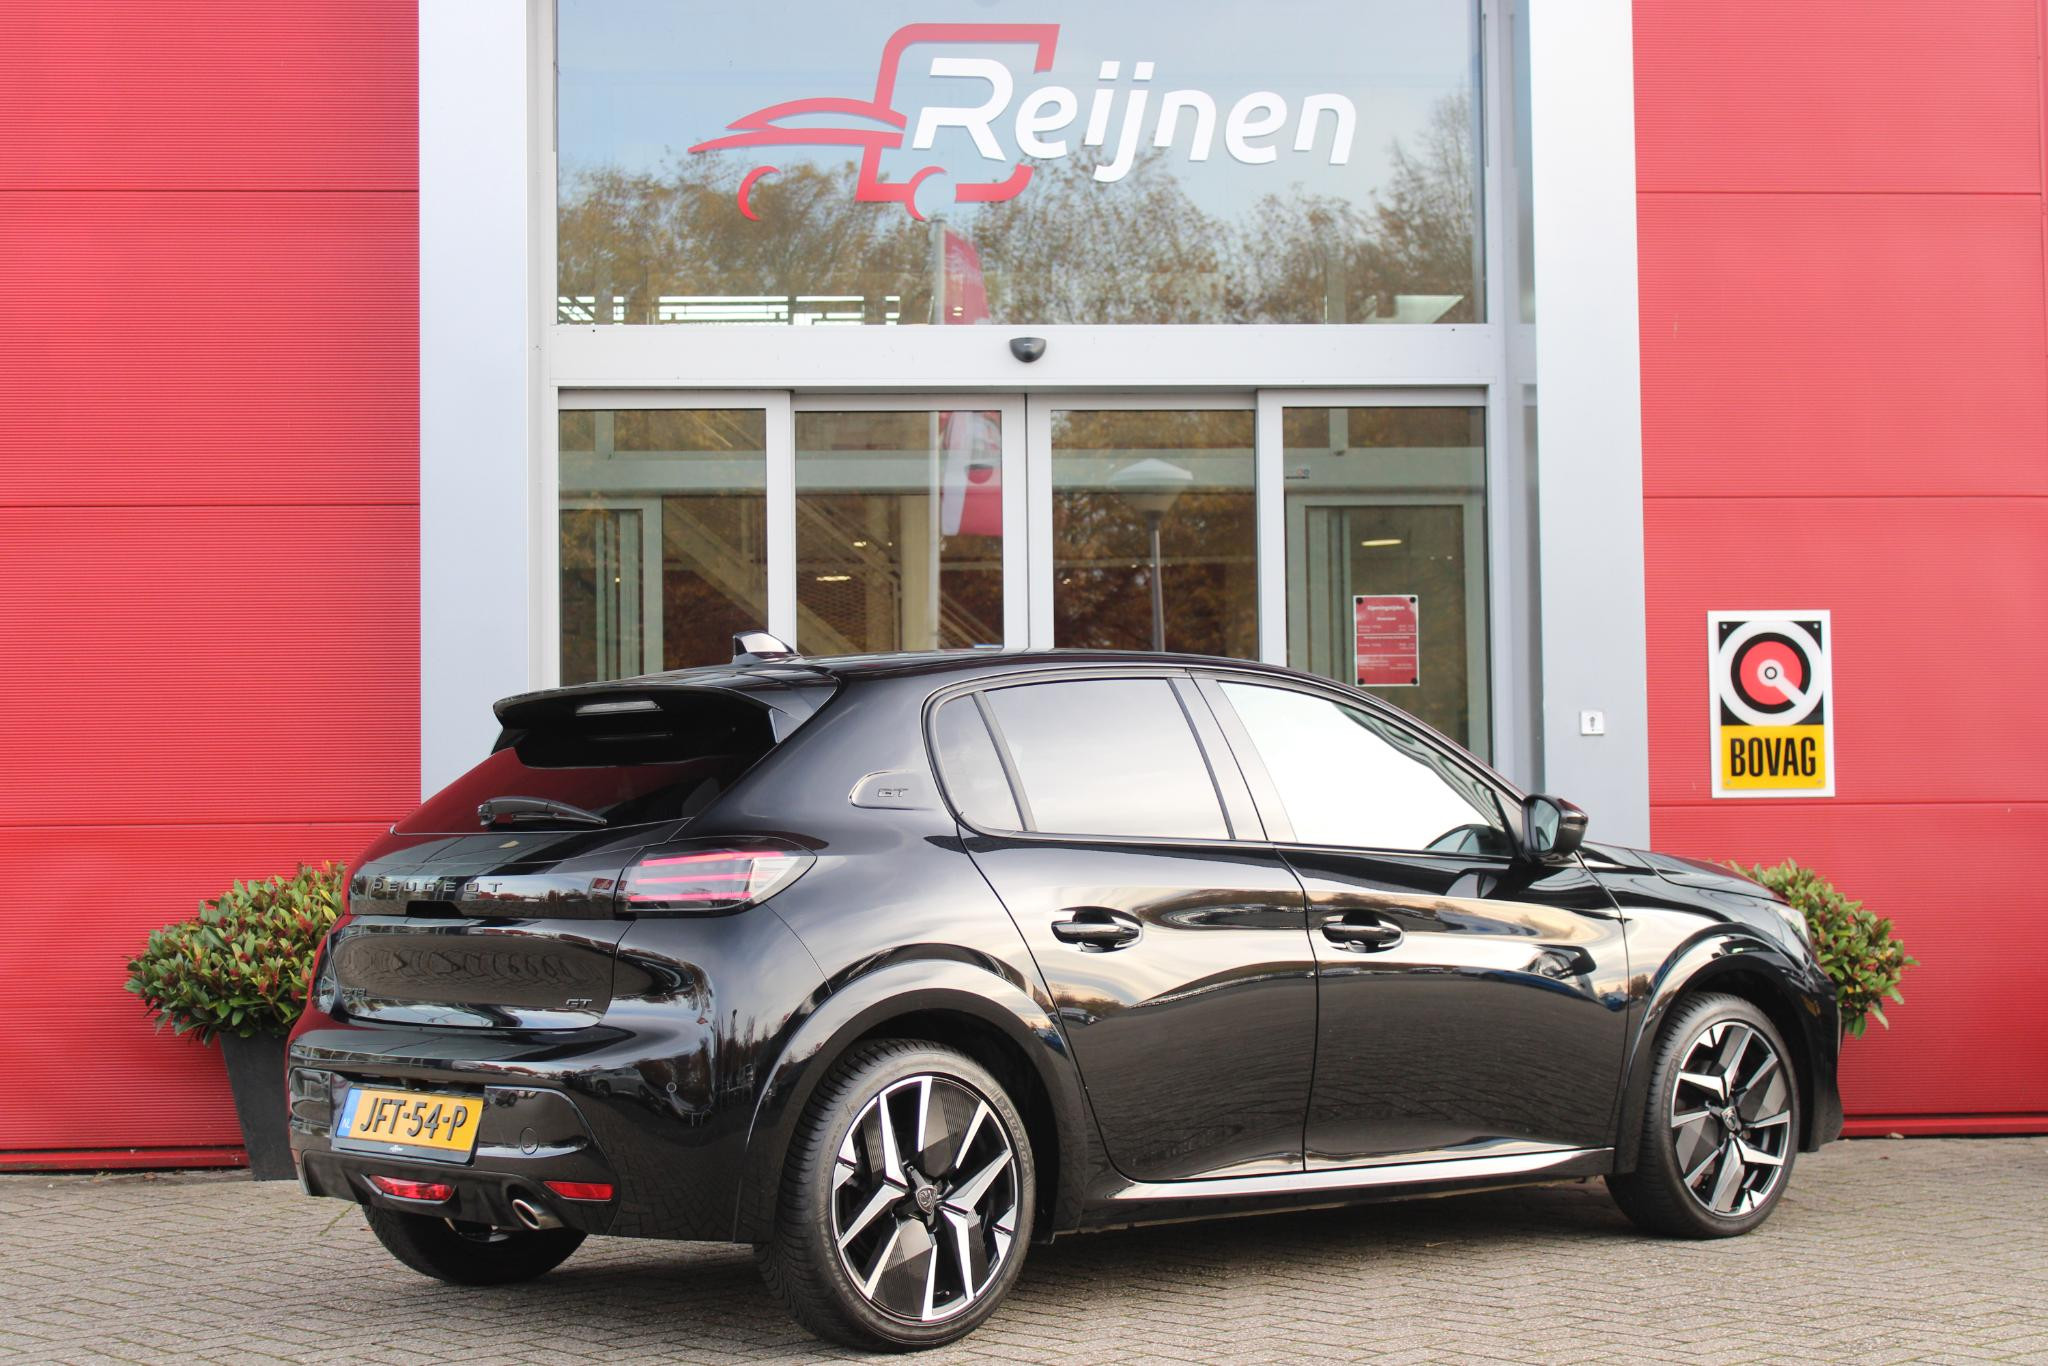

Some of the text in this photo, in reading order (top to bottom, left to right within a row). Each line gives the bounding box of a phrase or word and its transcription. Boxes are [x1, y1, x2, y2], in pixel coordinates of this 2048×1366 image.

[913, 57, 1356, 183] Reijnen
[1730, 737, 1817, 777] BOVAG
[373, 878, 502, 893] PEUGEOT
[565, 998, 592, 1009] GT
[360, 1097, 467, 1141] JFT-54-P
